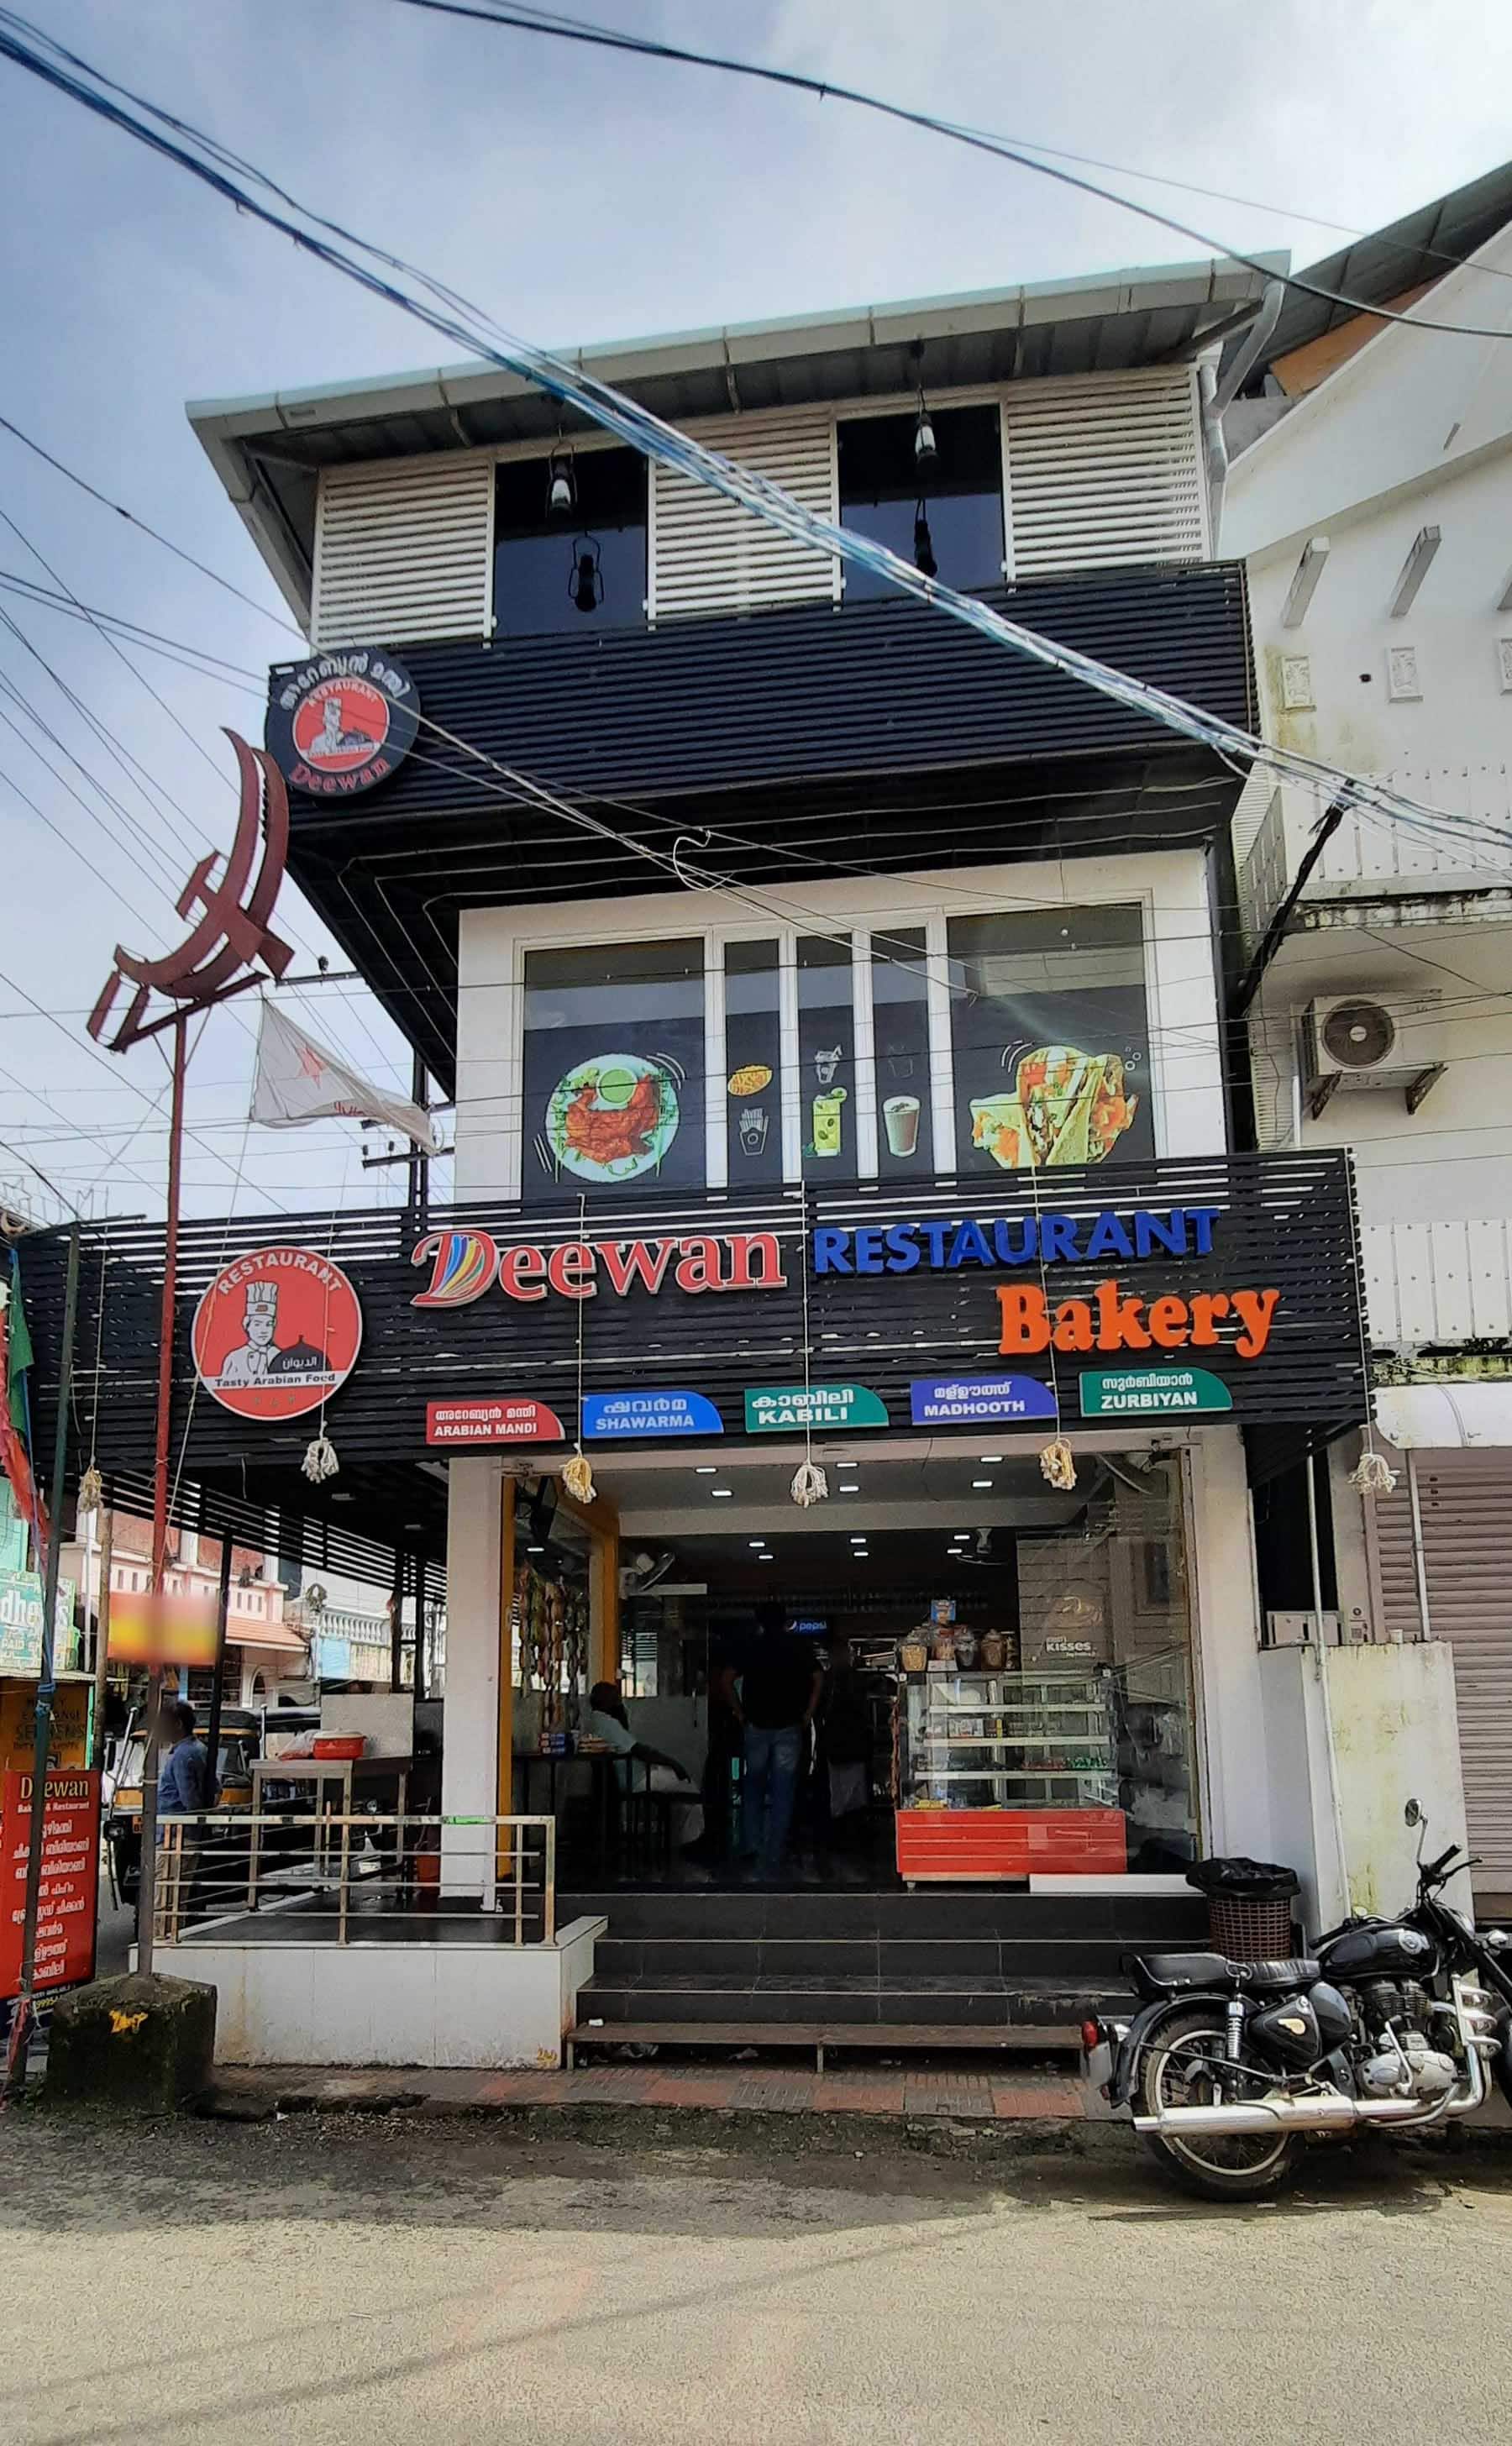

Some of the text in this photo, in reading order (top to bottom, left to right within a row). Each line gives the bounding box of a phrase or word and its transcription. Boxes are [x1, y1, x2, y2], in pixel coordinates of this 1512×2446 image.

[290, 757, 391, 793] Deewan
[814, 1208, 1220, 1273] RESTAURANT
[218, 1252, 343, 1295] RESTAURANT
[410, 1230, 788, 1308] Deewan
[996, 1279, 1279, 1357] Bakery
[215, 1373, 335, 1388] Tasty Arabian Food
[924, 1400, 1026, 1417] MADHOOTH
[1100, 1391, 1198, 1409] ZURBIYAN
[596, 1415, 695, 1430] SHAWARMA
[759, 1406, 848, 1425] KABILI
[434, 1423, 537, 1436] ARABIAN MANDI
[800, 1621, 827, 1630] pepsi
[20, 1777, 89, 1799] Dewan
